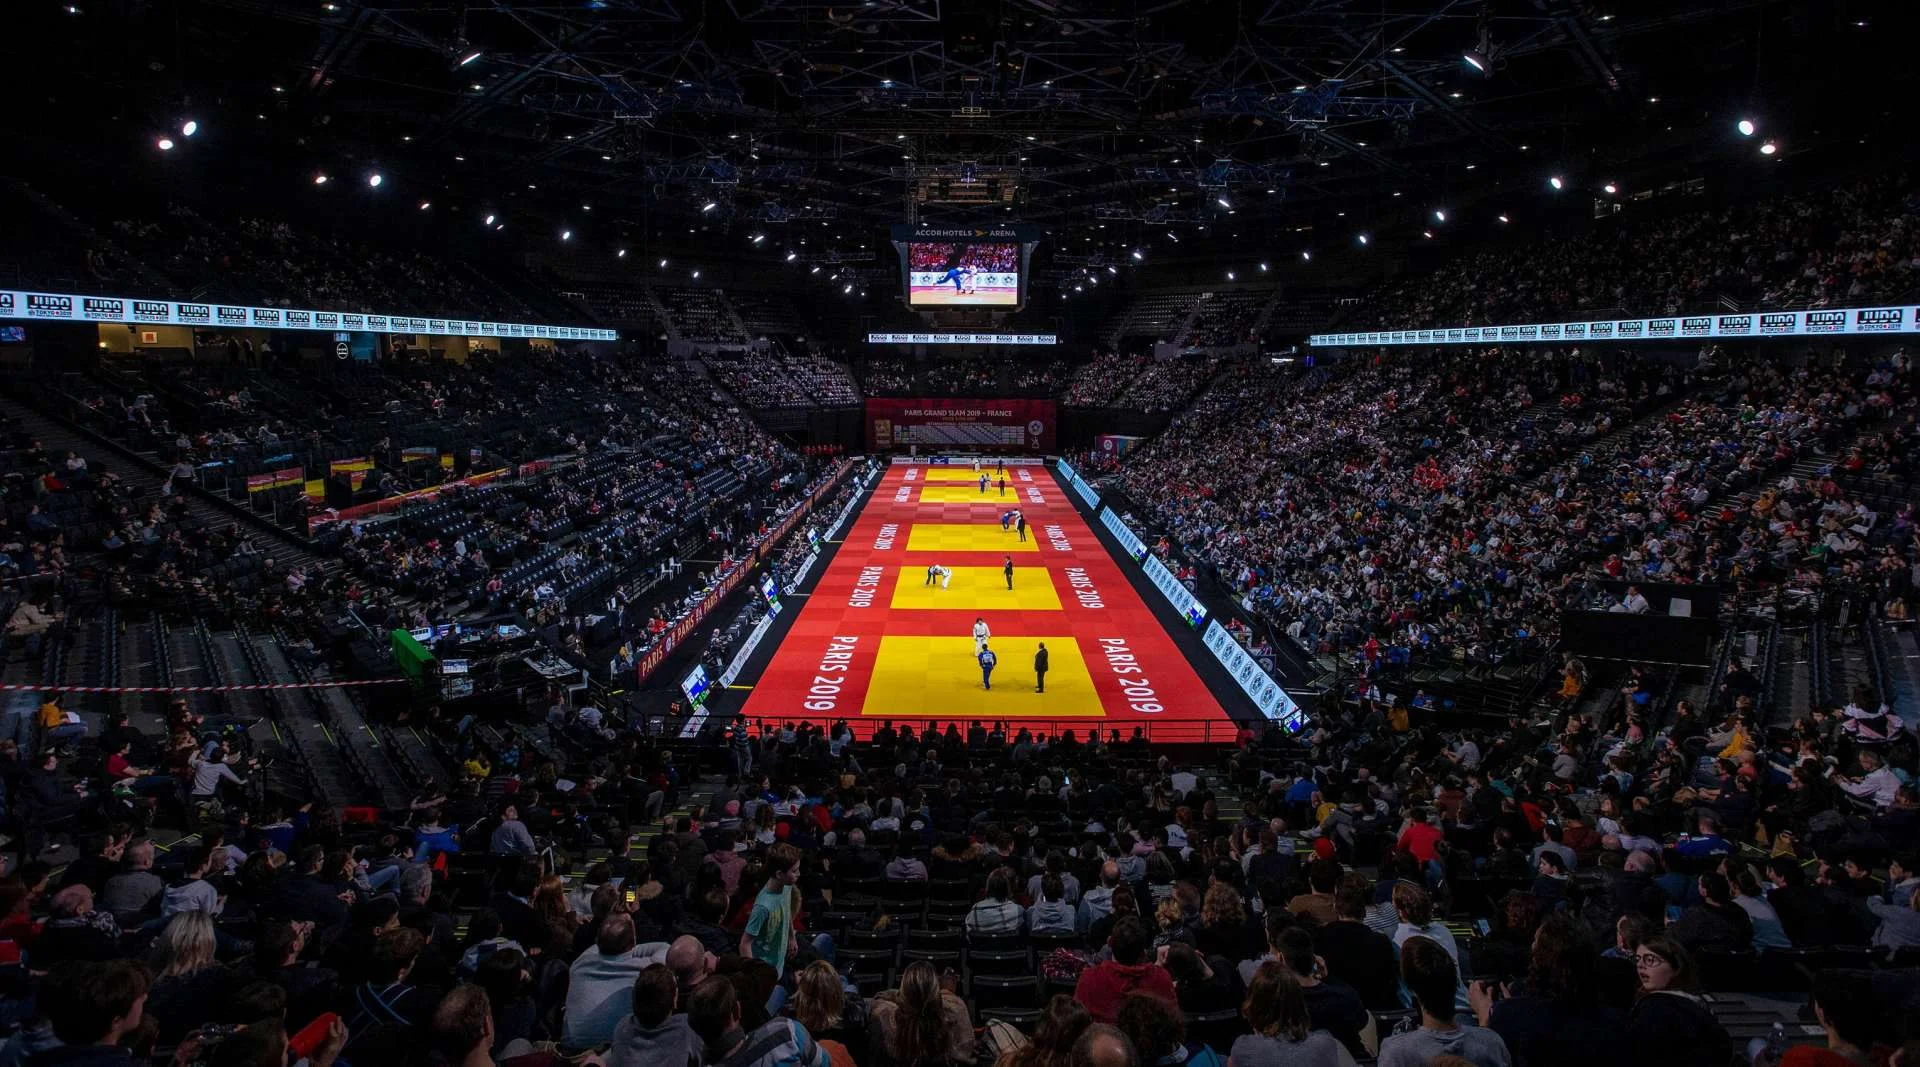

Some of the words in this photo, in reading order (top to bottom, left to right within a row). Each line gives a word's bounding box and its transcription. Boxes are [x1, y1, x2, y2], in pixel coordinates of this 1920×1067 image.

[30, 296, 70, 310] JUDO
[86, 300, 121, 312] JUDO
[136, 303, 167, 314] JUDO
[180, 306, 208, 316] JUDO
[219, 308, 245, 318] JUDO
[1684, 319, 1709, 329] JUDO
[1721, 318, 1749, 328] JUDO
[1762, 316, 1794, 326] JUDO
[1808, 313, 1844, 325] JUDO
[1860, 311, 1900, 323] JUDO
[857, 566, 884, 587] PARIS
[1064, 567, 1093, 588] PARIS
[703, 593, 718, 615] PARIS
[849, 588, 876, 608] 2019
[1076, 589, 1104, 609] 2019
[677, 614, 694, 638] PARIS
[642, 646, 663, 677] PARIS
[820, 636, 859, 672] PARIS
[1098, 638, 1142, 674] PARIS
[804, 676, 845, 711] 2019
[1118, 678, 1164, 713] 2019
